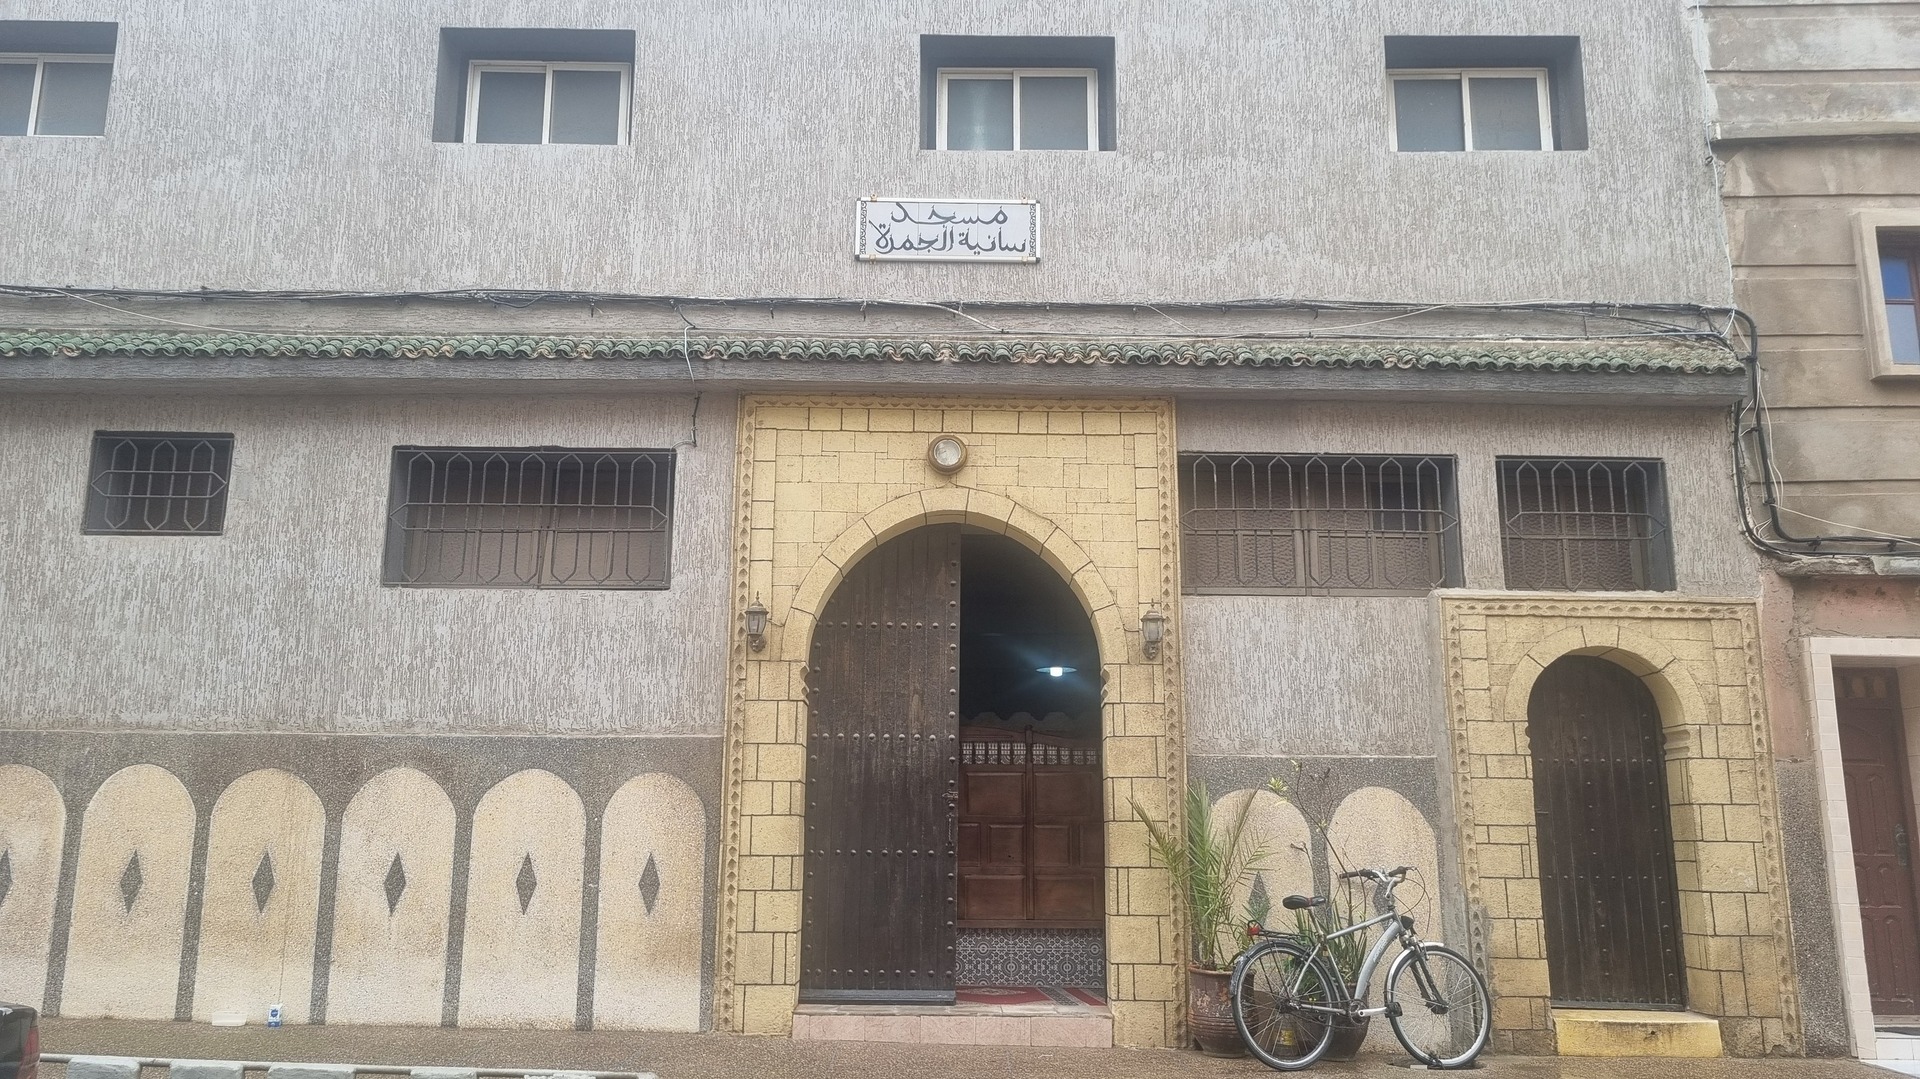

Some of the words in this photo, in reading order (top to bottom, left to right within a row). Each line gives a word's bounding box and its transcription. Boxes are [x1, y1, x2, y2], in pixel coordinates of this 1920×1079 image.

[890, 202, 1009, 228] مسجد
[868, 220, 954, 255] الجمرة
[958, 226, 1027, 256] سانية
